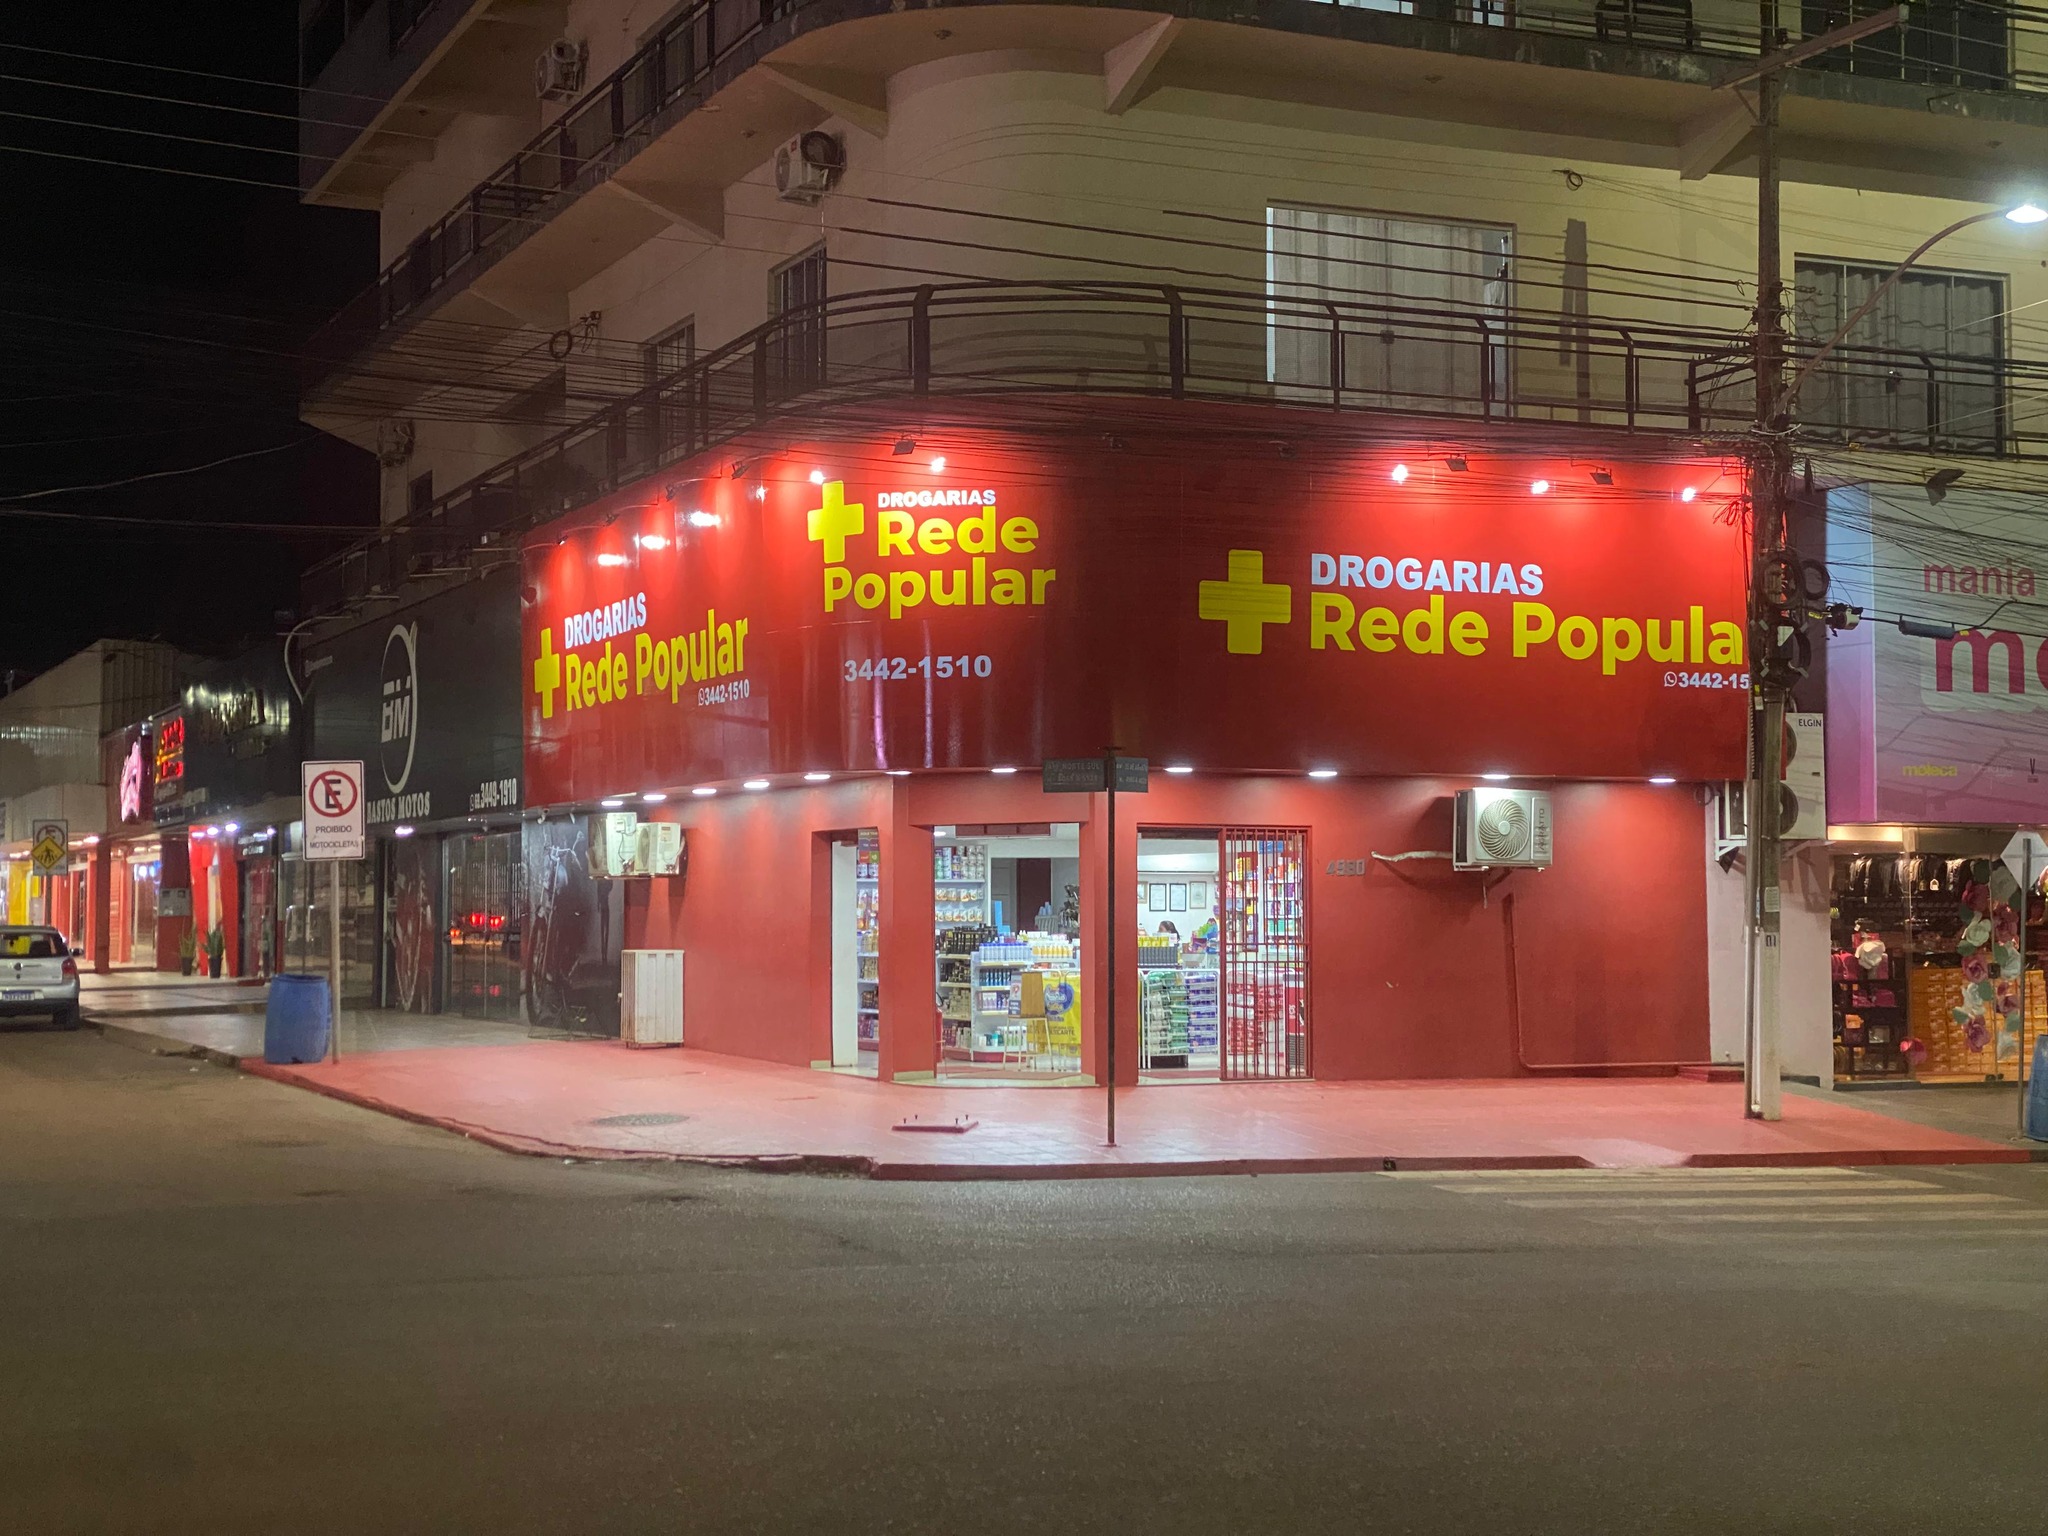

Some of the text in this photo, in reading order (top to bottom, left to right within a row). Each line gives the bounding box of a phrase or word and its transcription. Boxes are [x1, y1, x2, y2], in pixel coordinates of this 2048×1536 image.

[877, 489, 996, 506] DROGARIAS
[878, 506, 1039, 555] Rede
[824, 556, 1056, 619] Popular
[1311, 553, 1544, 597] DROGARIAS
[1924, 557, 2035, 596] mania
[564, 592, 647, 649] DROGARIAS
[1311, 591, 1744, 676] Rede Popula
[566, 608, 748, 711] Rede Popular
[844, 655, 992, 682] 3442-1510
[1936, 627, 2048, 694] m
[705, 679, 749, 705] 3442-1510
[1678, 672, 1749, 690] 3442-15
[1798, 718, 1822, 727] ELGIN
[1902, 762, 1958, 777] moleca
[398, 791, 431, 819] MOTOS
[315, 825, 352, 834] PROIBIDO
[309, 840, 359, 849] MOTOCICLETAS
